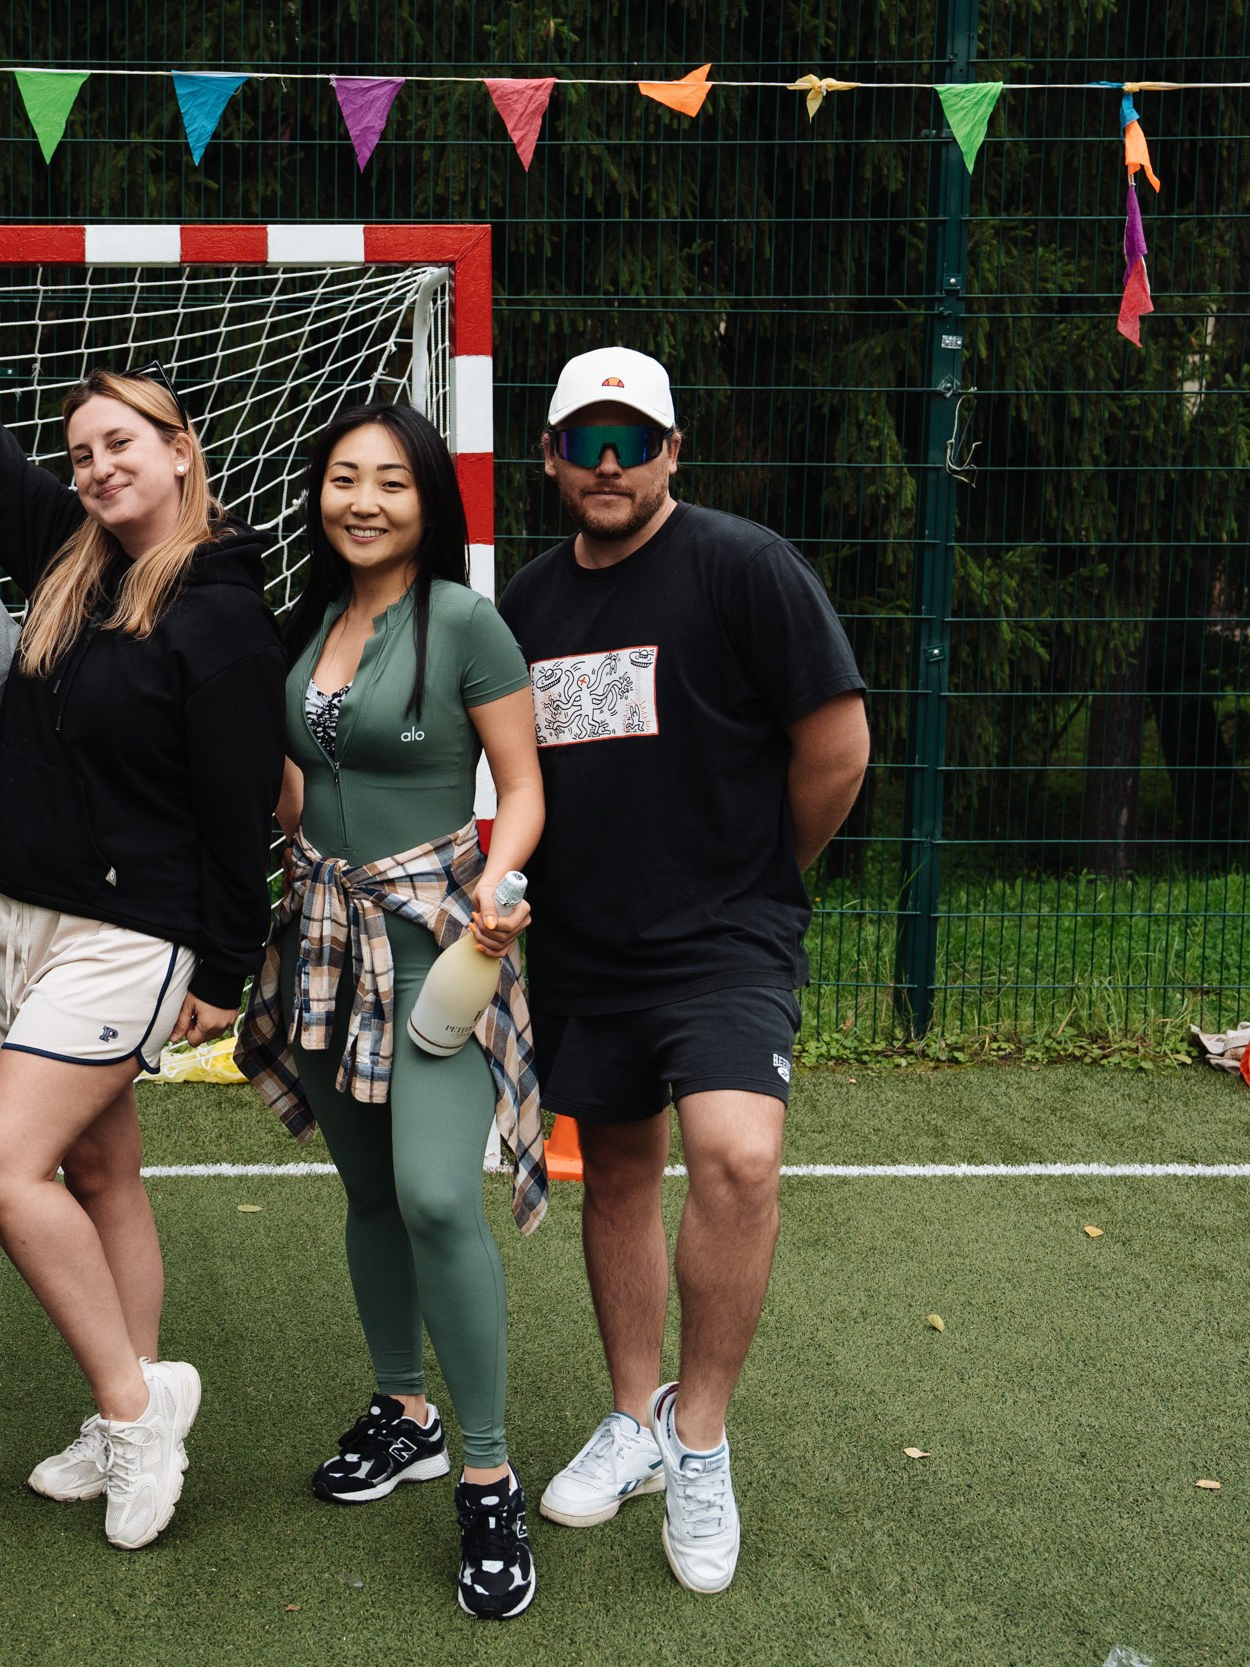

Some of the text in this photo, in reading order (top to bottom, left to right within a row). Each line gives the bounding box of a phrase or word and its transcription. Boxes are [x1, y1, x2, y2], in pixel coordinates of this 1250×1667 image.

[400, 725, 425, 742] alo
[98, 1025, 119, 1043] P
[388, 1436, 418, 1462] N
